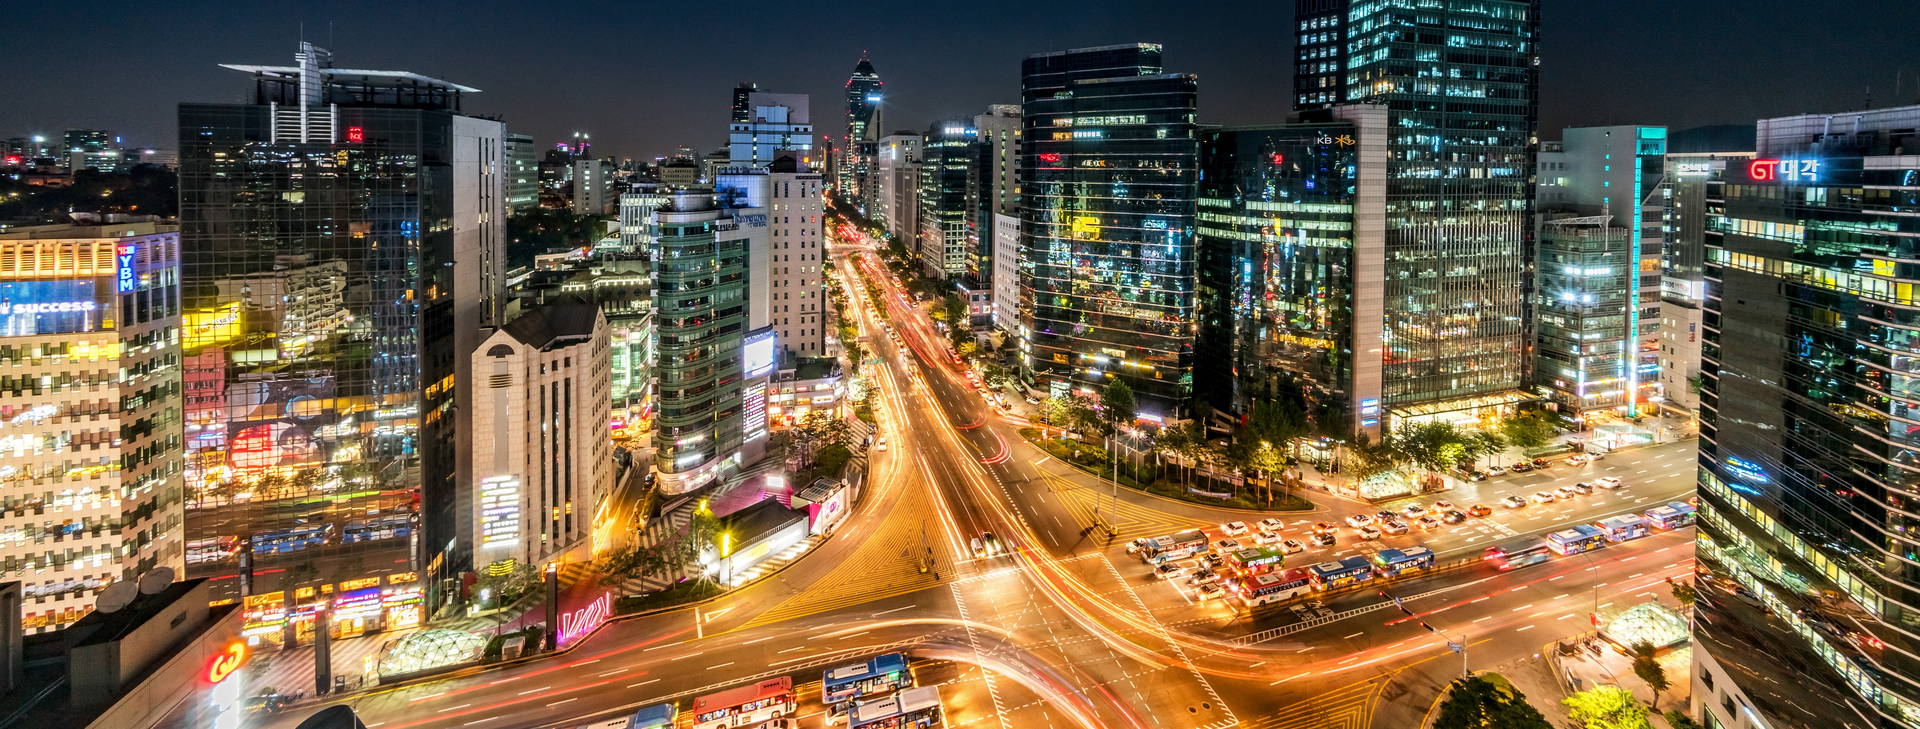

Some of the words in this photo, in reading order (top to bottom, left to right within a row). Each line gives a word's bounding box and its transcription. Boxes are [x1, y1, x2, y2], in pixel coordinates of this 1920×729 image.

[1317, 137, 1332, 145] KB
[119, 255, 134, 292] YBM
[12, 301, 96, 315] success
